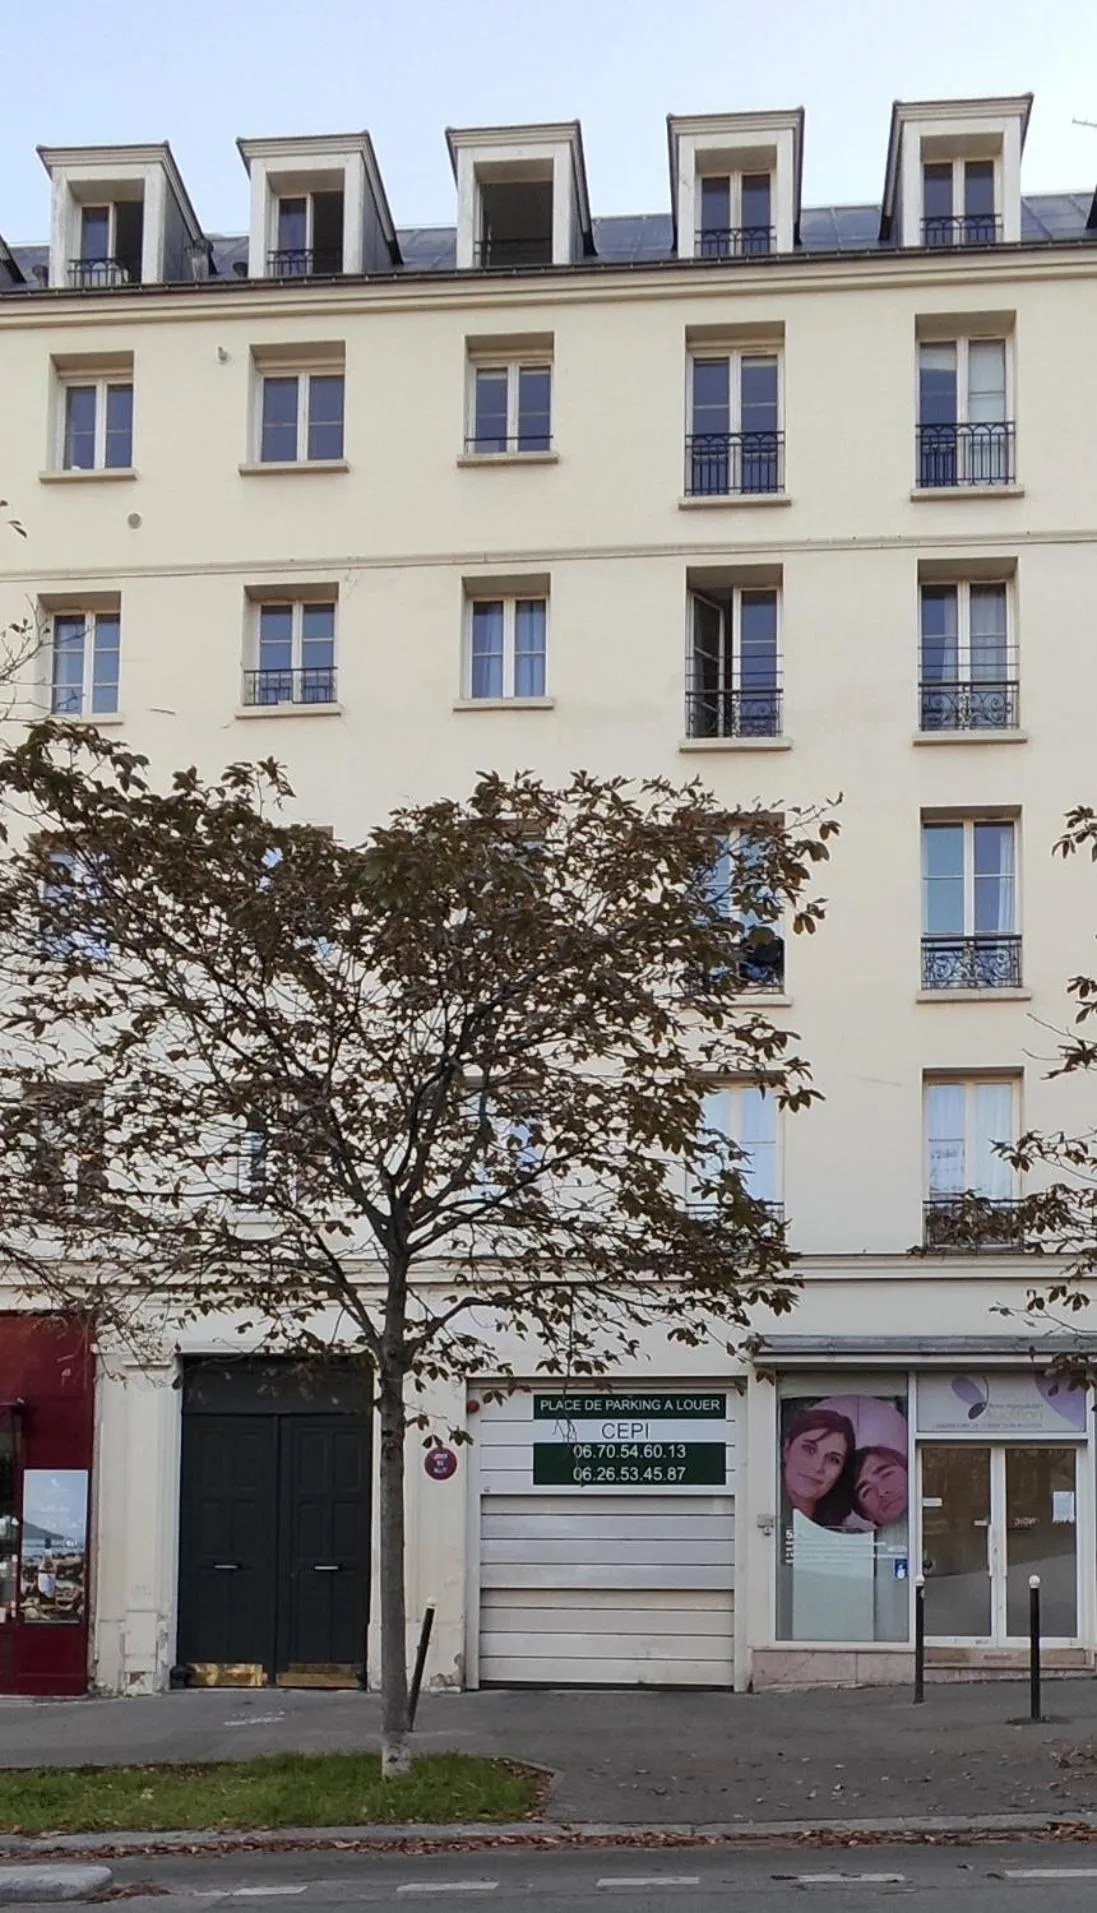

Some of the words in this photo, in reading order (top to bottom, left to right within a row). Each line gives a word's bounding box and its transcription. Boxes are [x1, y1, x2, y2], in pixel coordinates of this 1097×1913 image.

[540, 1400, 581, 1411] PLACE
[584, 1400, 601, 1411] DE
[605, 1400, 661, 1411] PARKING
[664, 1400, 674, 1411] A
[677, 1400, 720, 1411] LOUER
[601, 1422, 649, 1440] CEPI
[573, 1445, 686, 1458] 06.70.54.60.13
[573, 1467, 686, 1481] 06.26.53.45.87
